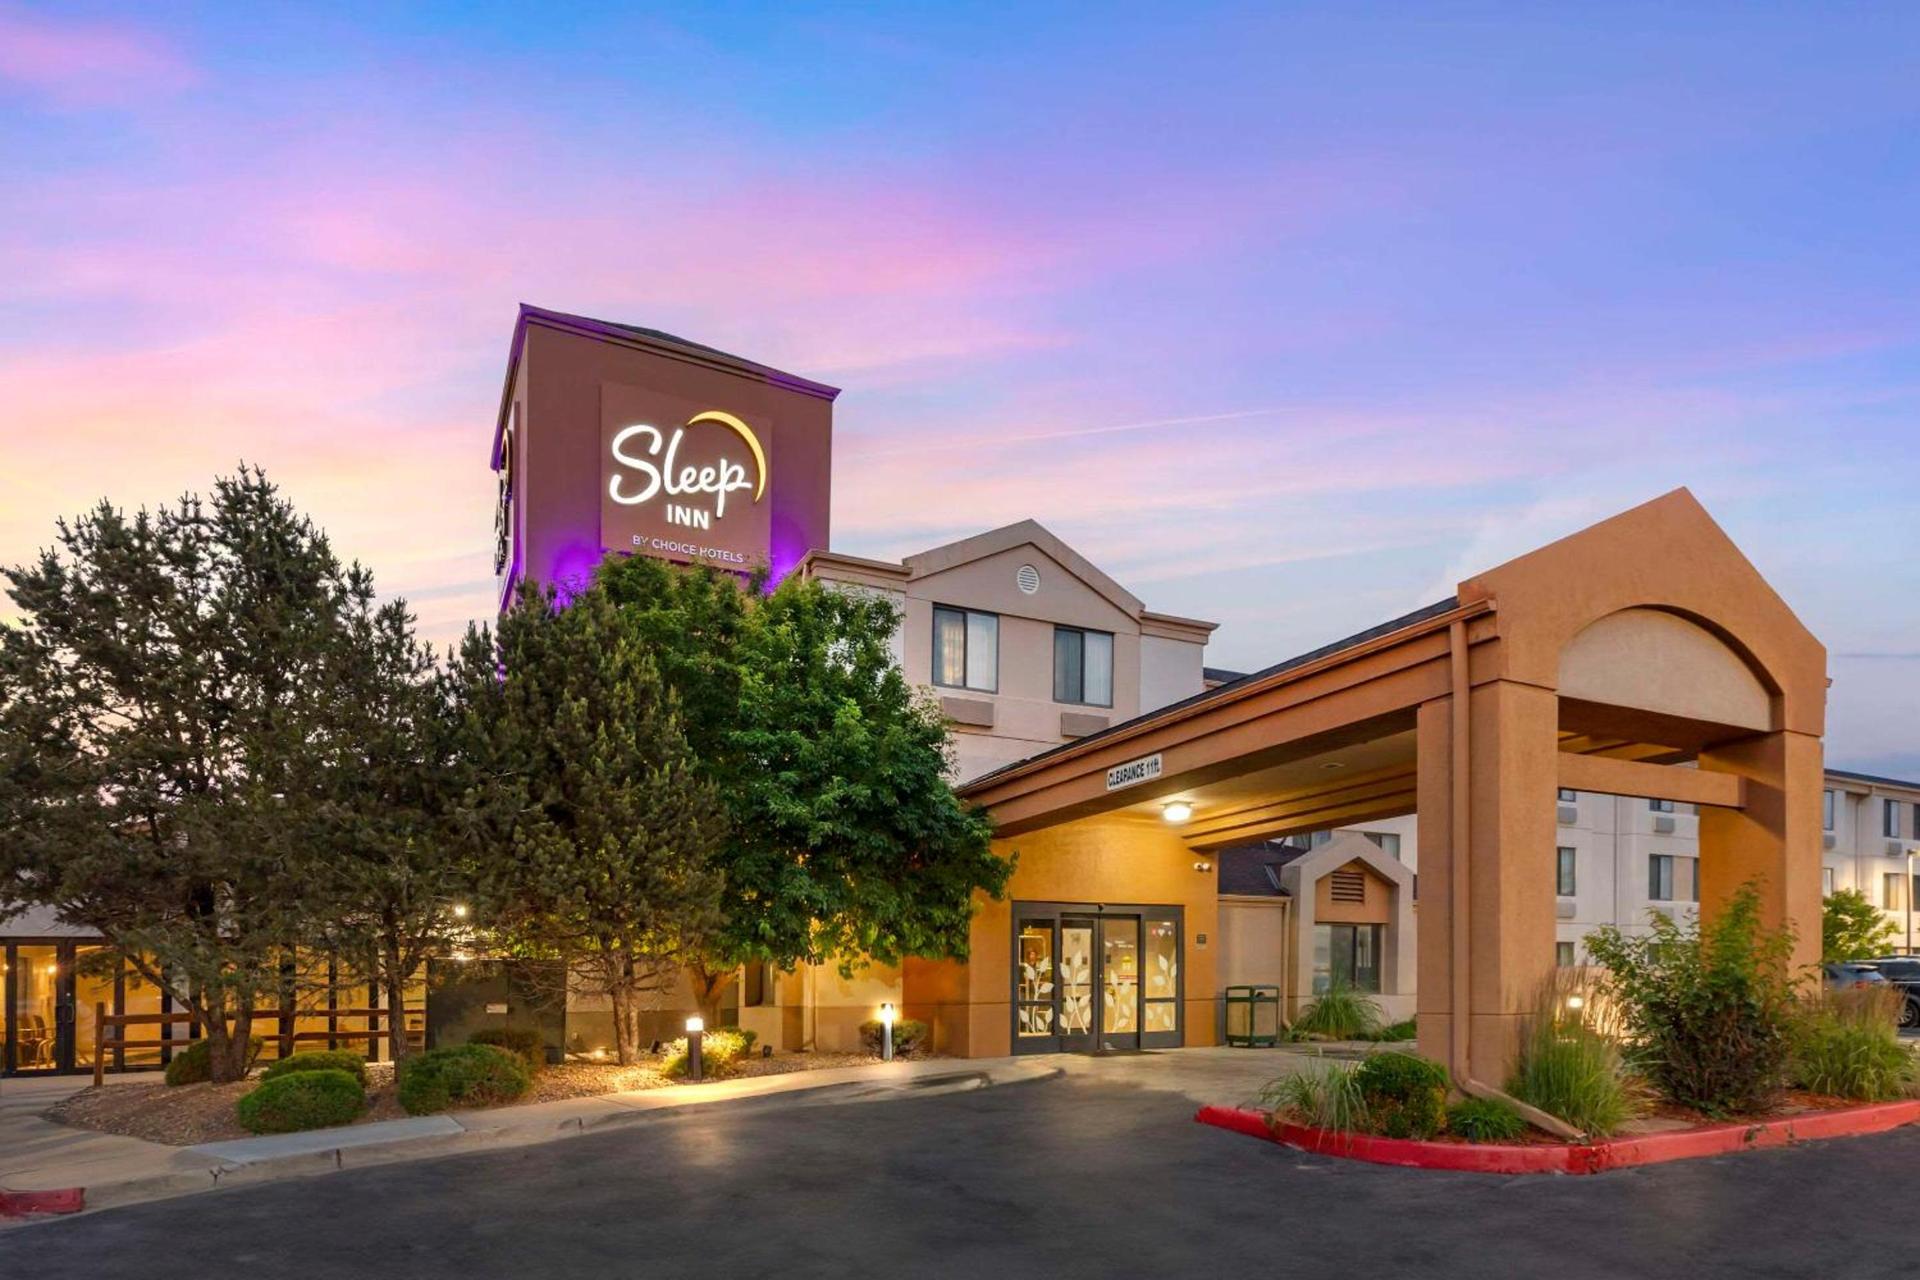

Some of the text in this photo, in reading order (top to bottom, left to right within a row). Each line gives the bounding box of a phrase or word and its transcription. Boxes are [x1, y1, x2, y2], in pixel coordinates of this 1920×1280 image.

[608, 424, 753, 518] Sleep
[667, 504, 709, 530] INN
[632, 535, 744, 563] BY CHOICE HOTELS
[1108, 763, 1145, 787] CLEARANCE
